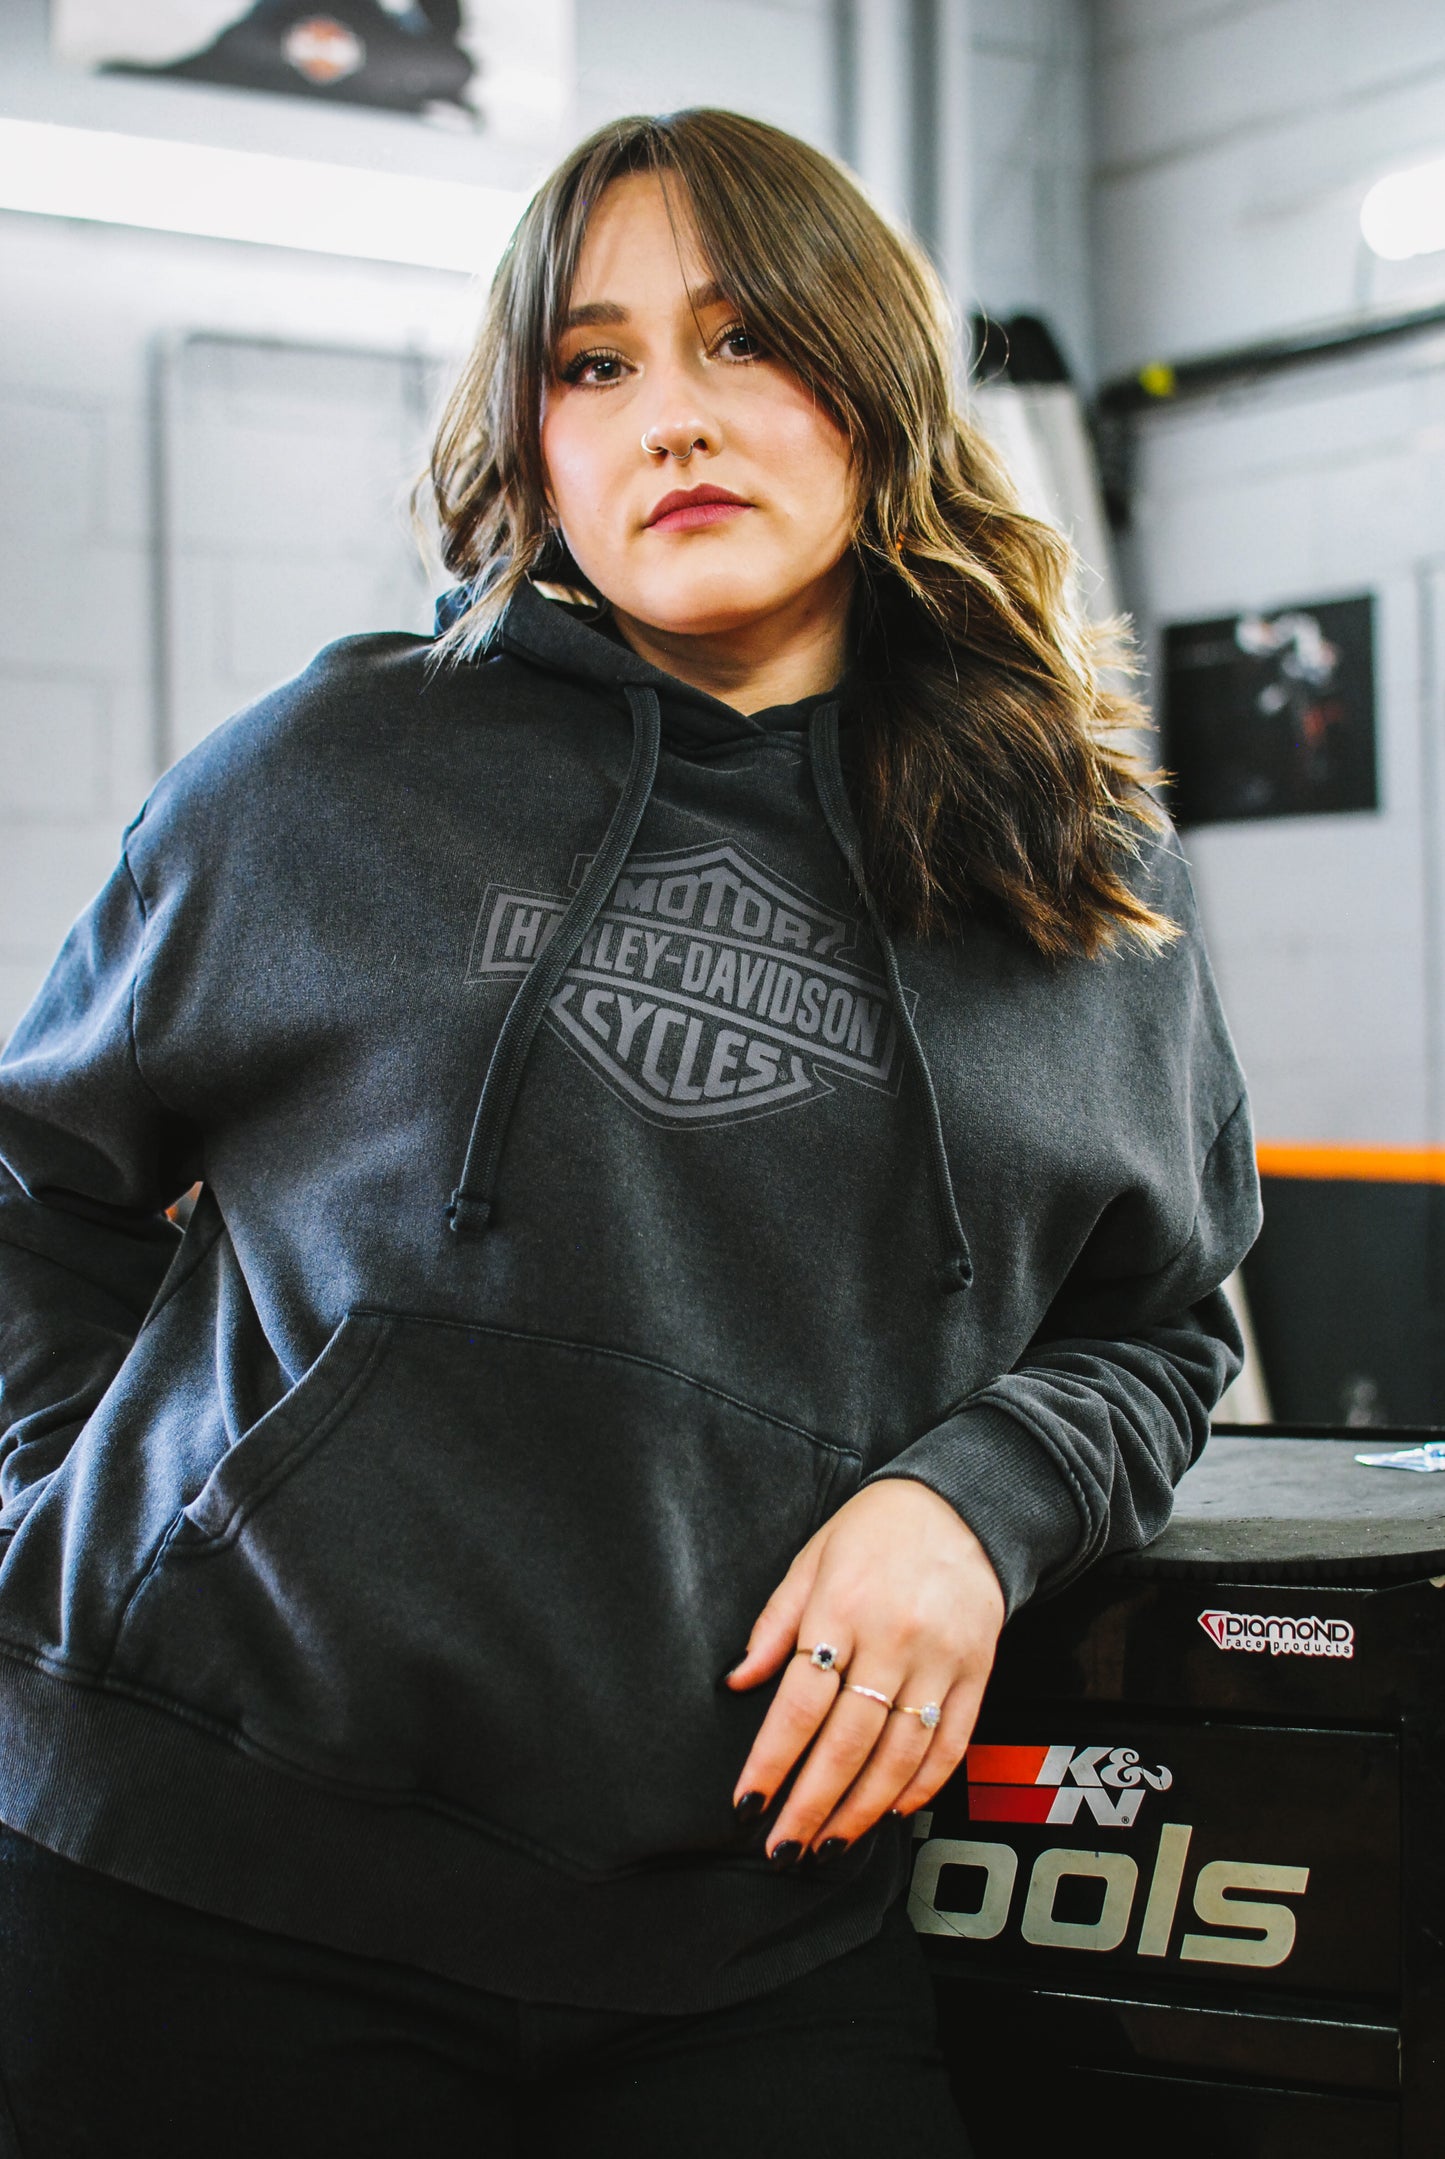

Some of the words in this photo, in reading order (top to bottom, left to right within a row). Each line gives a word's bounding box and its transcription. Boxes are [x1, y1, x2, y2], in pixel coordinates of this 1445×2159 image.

[612, 865, 811, 951] MOTOR
[581, 989, 781, 1101] CYCLES
[1225, 1638, 1263, 1649] race
[1273, 1641, 1350, 1654] products
[906, 1811, 1310, 1968] ools
